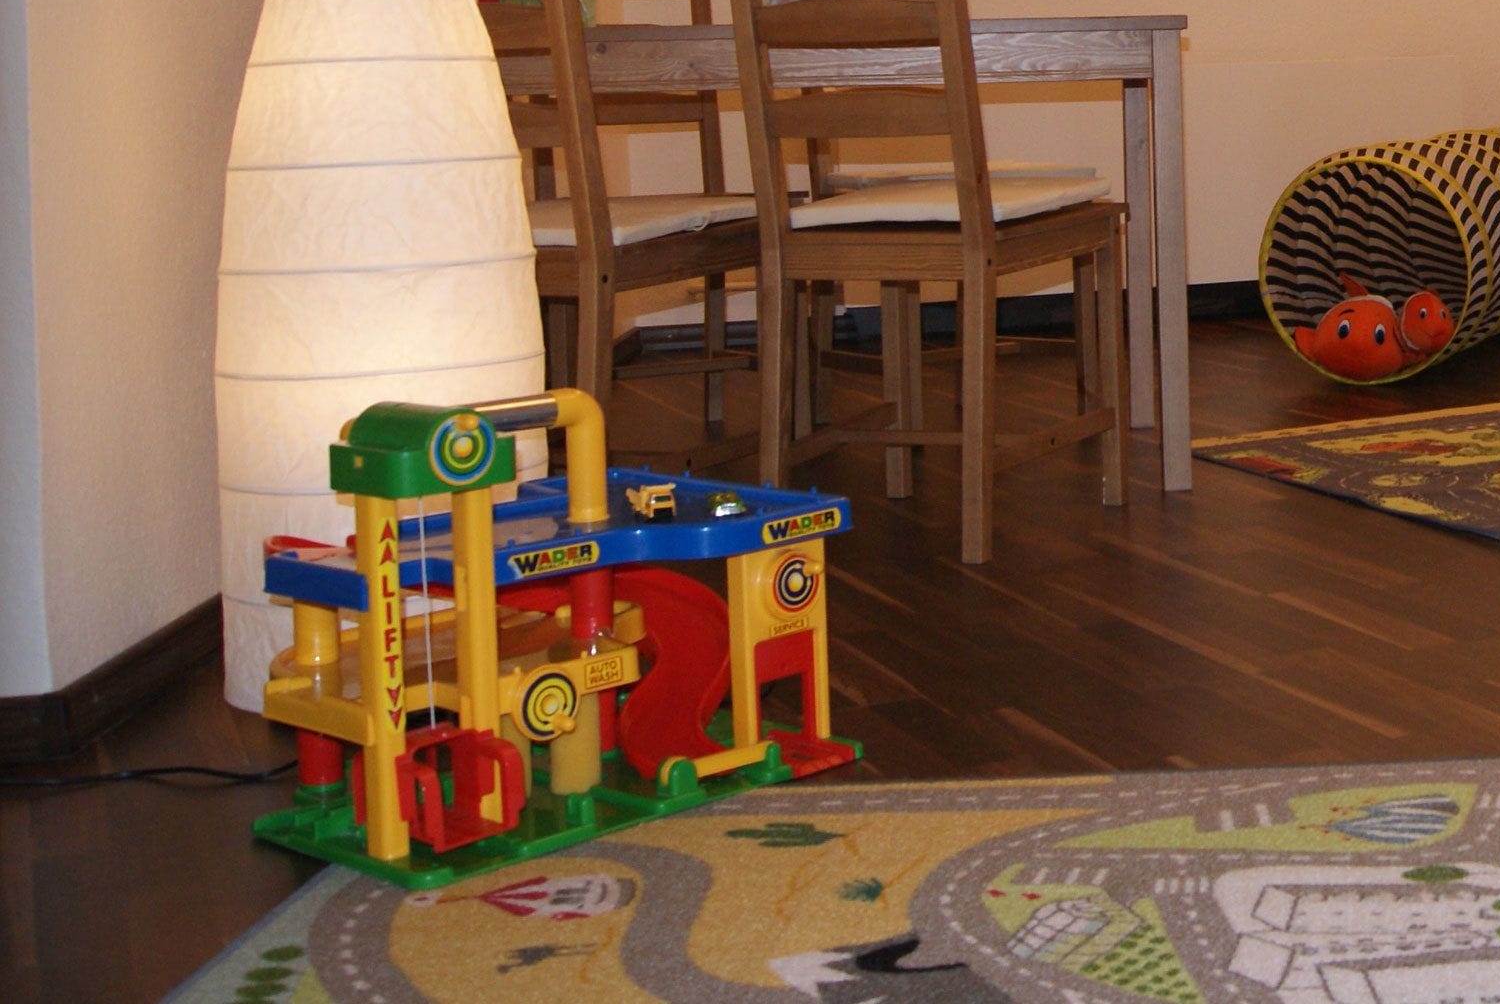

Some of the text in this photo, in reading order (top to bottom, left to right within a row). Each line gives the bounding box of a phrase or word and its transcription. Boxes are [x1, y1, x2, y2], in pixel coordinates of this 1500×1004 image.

[767, 510, 836, 540] WADER
[513, 544, 592, 574] WADER
[382, 575, 399, 678] LIFT
